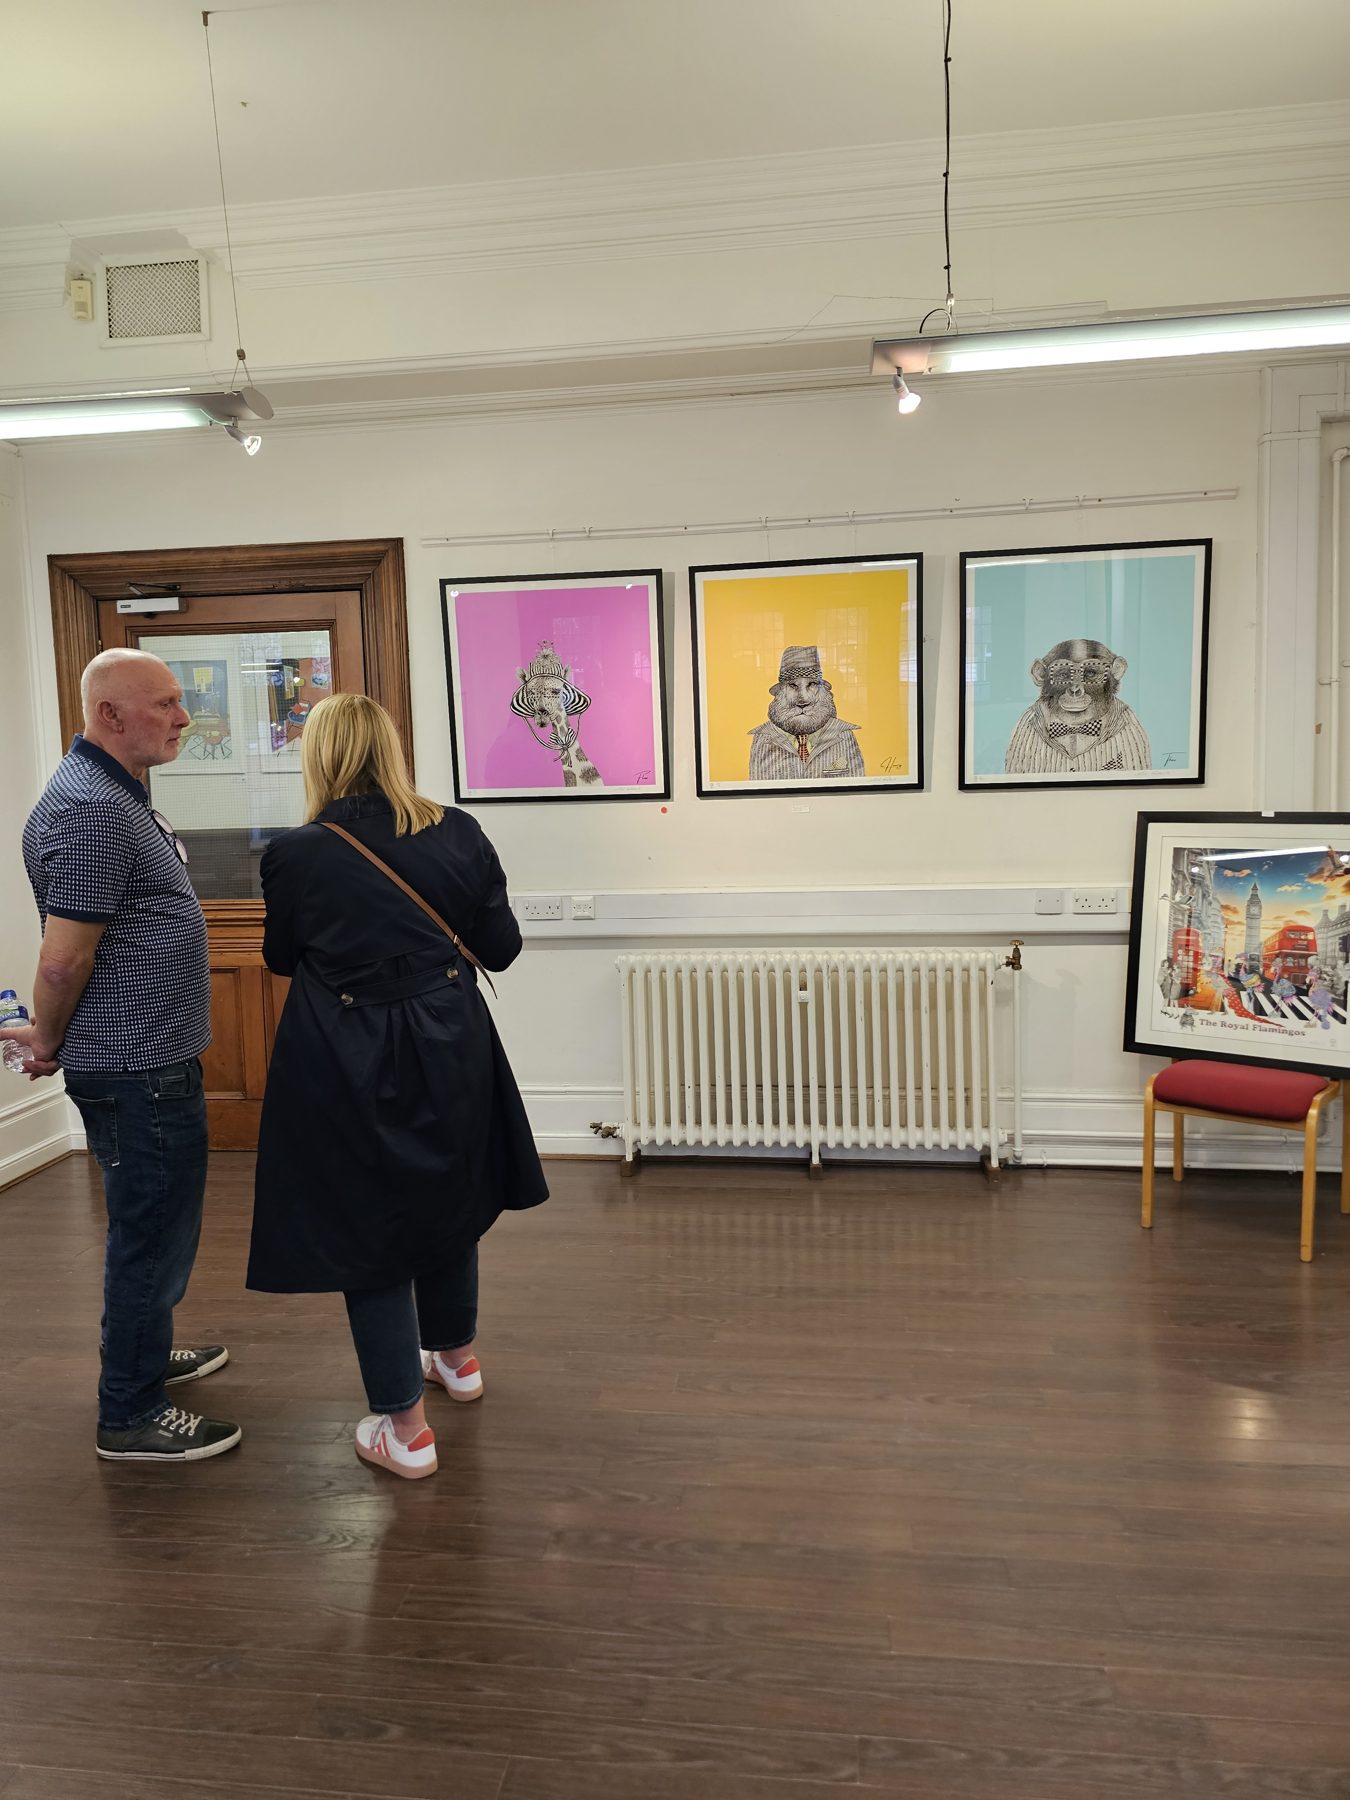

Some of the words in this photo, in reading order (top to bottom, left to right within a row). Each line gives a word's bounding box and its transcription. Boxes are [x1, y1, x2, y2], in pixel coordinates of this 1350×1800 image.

[1199, 1018, 1217, 1026] The
[1220, 1020, 1249, 1031] Royal
[1252, 1025, 1306, 1036] Flamingos
